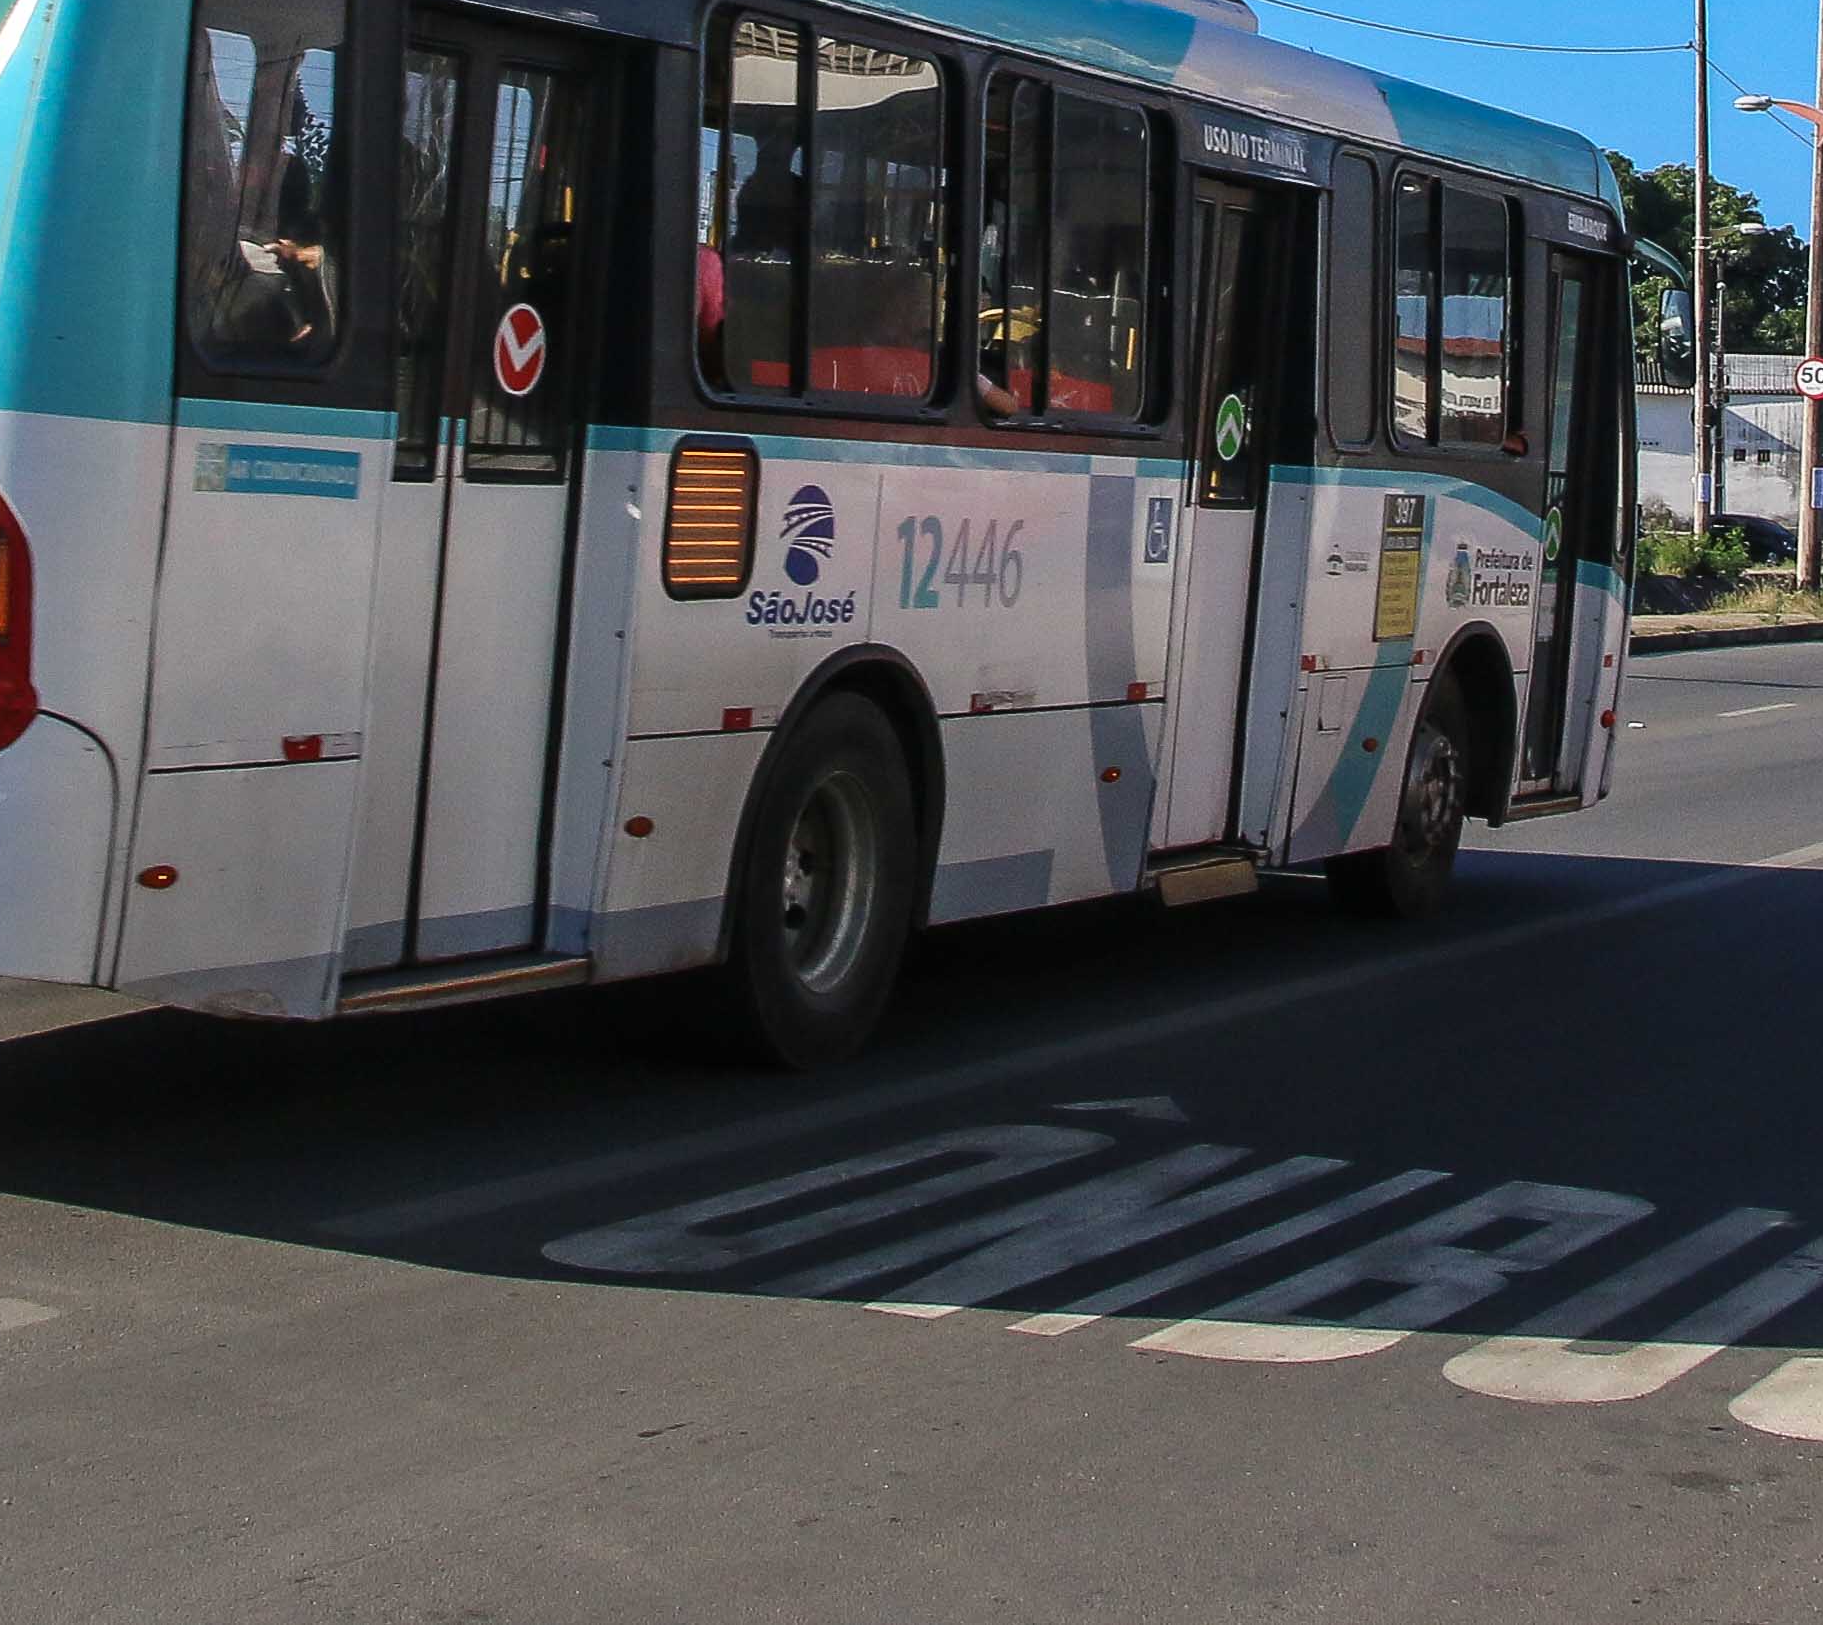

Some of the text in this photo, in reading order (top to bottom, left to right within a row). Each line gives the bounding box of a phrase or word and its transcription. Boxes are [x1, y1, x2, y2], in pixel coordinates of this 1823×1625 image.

[1203, 124, 1230, 154] USO
[1231, 131, 1249, 158] NO
[897, 514, 1025, 609] 12446
[1521, 551, 1534, 570] de
[1472, 573, 1530, 607] Fortaleza
